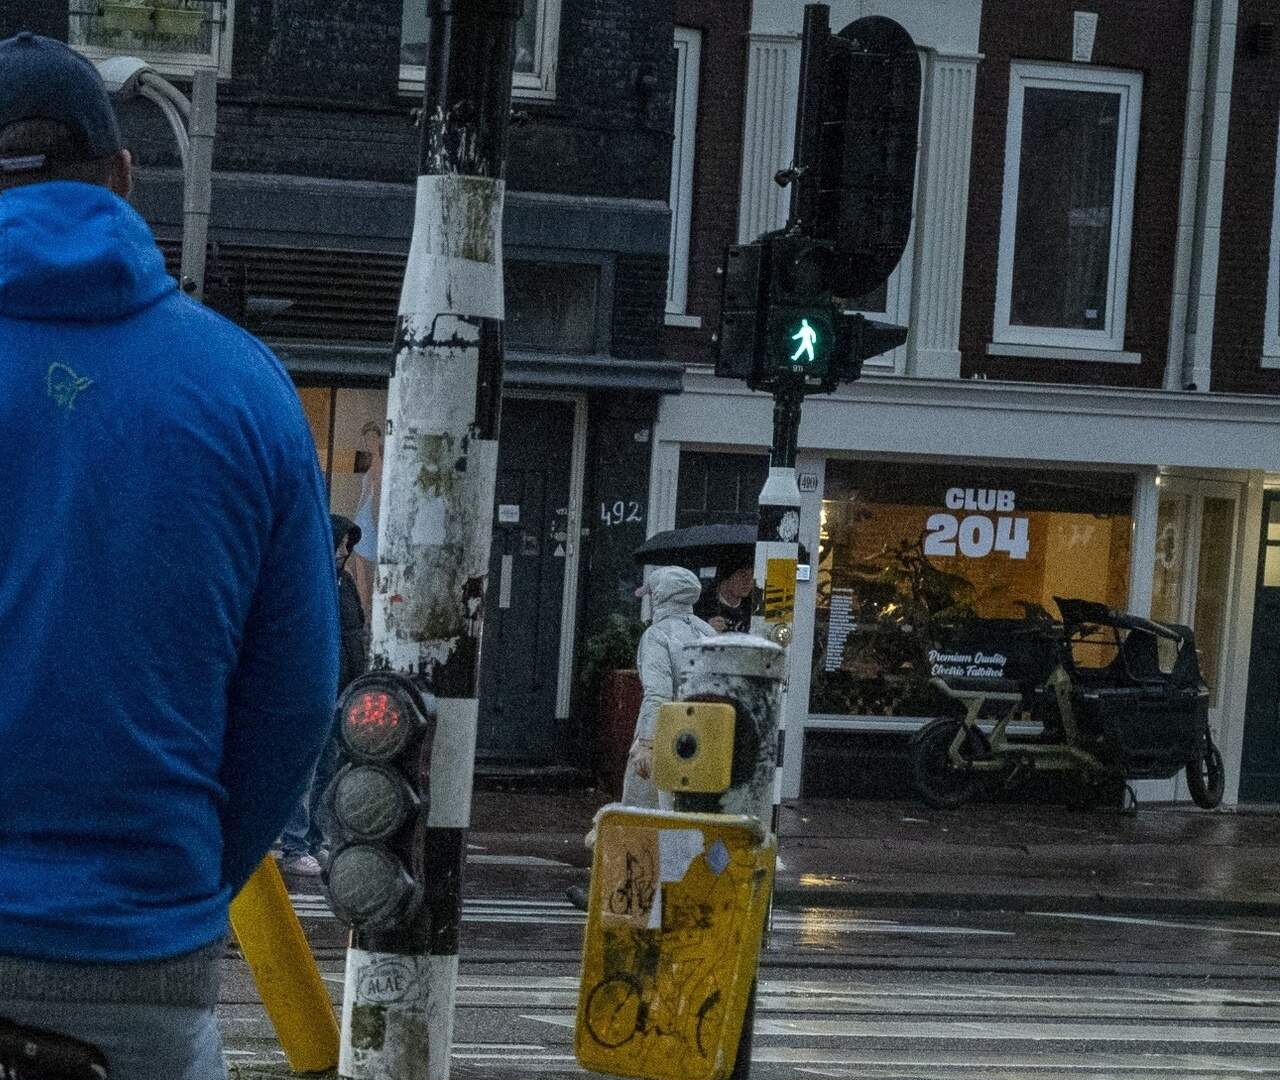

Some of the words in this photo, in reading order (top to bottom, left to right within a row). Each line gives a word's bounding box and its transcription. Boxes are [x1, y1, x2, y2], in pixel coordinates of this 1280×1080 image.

[945, 487, 1016, 512] CLUB
[601, 501, 642, 525] 492
[924, 513, 1030, 559] 204
[928, 650, 972, 664] Premium
[974, 651, 1007, 667] Quality
